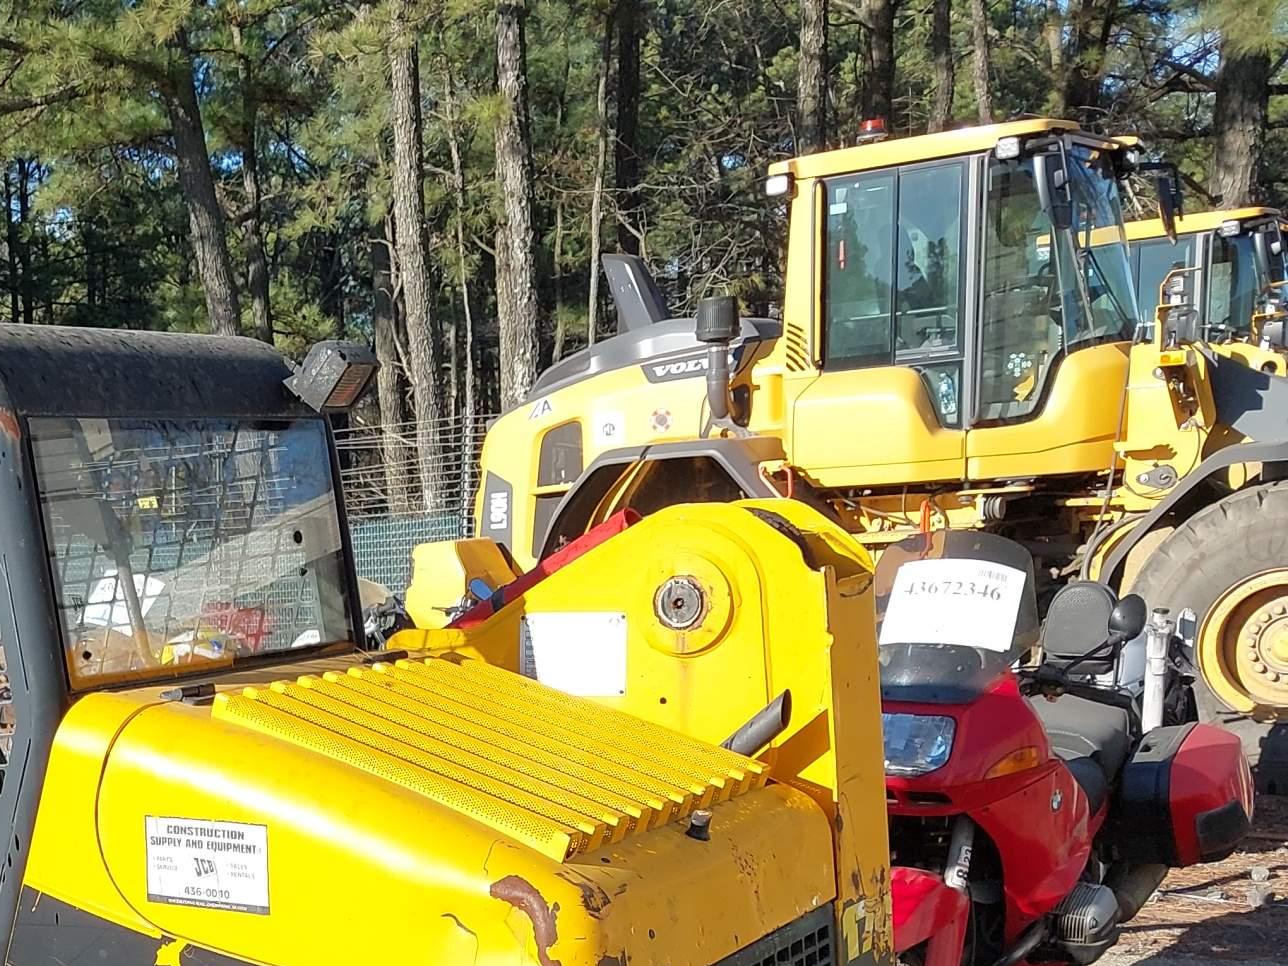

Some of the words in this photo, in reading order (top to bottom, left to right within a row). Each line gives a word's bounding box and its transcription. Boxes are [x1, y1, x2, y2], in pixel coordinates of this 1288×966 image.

[490, 492, 508, 530] L90H
[166, 824, 245, 841] CONSTRUCTION
[150, 835, 182, 848] SUPPLY
[185, 838, 204, 849] AND
[206, 840, 257, 855] EQUIPMENT
[193, 857, 215, 877] JCB
[184, 886, 231, 900] 436-0010
